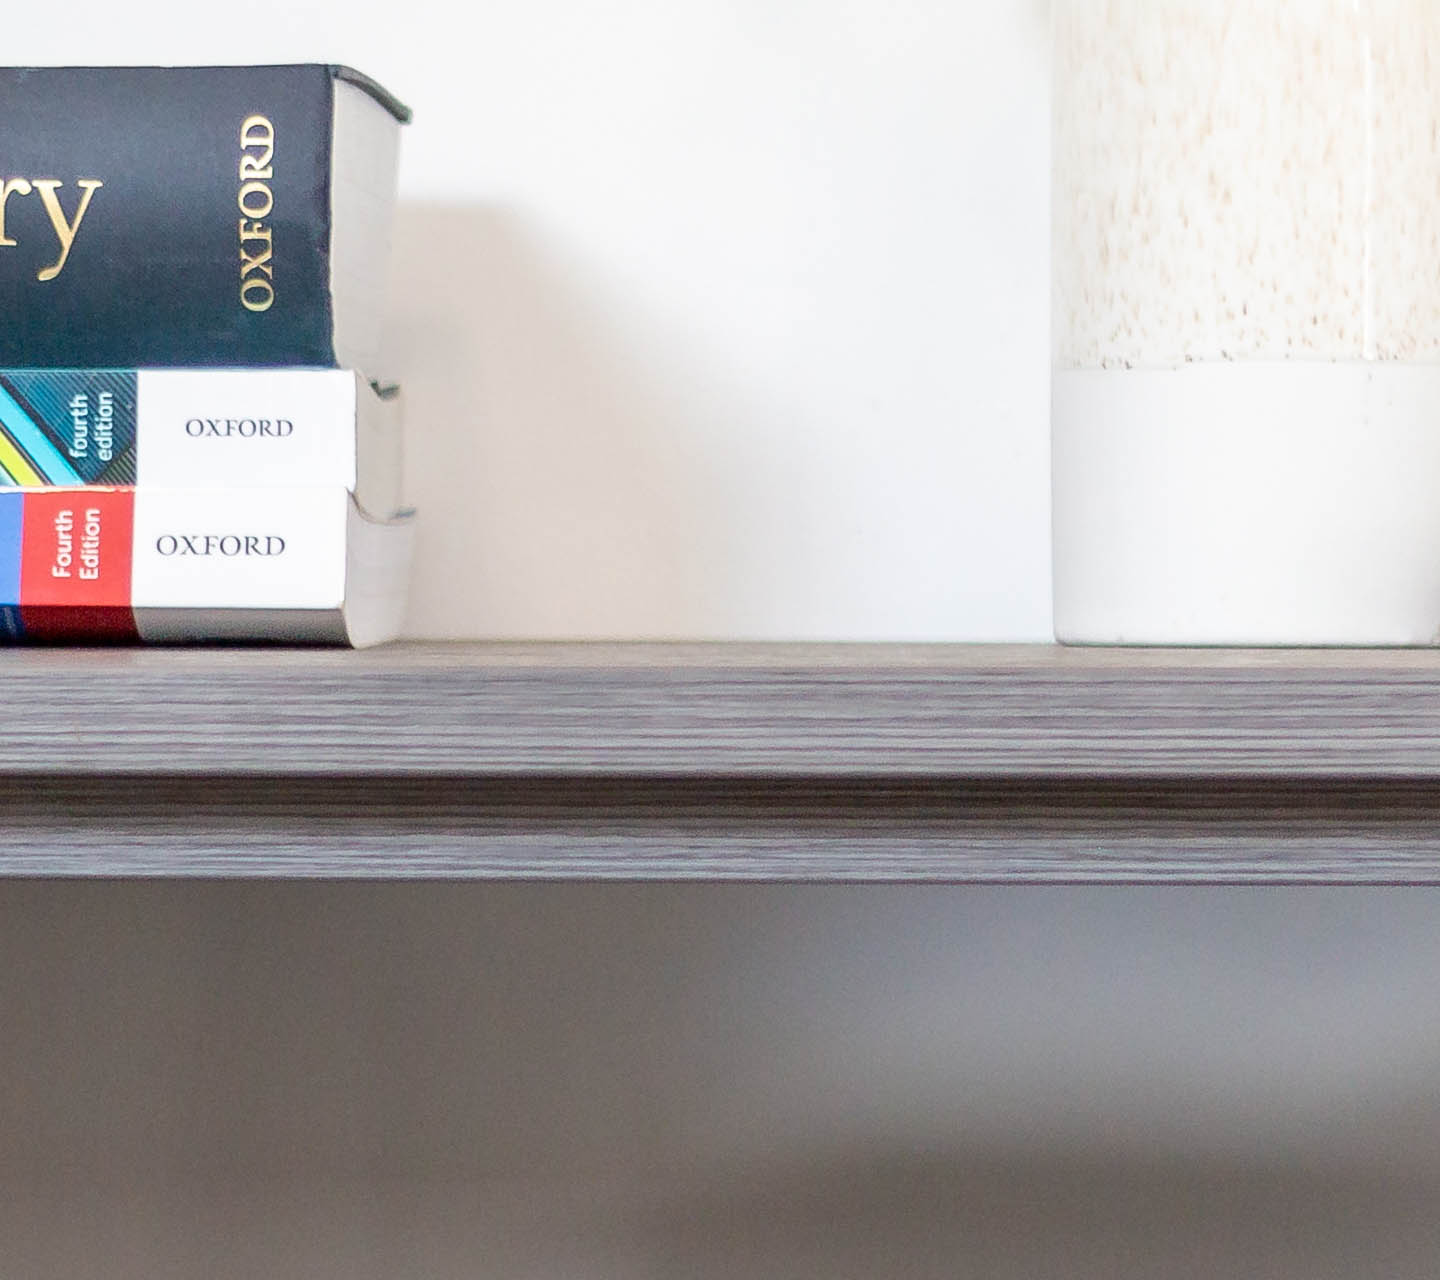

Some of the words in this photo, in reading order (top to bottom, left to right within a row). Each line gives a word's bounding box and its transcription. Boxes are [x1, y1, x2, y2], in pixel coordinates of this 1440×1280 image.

[238, 115, 274, 311] OXFORD
[69, 394, 87, 460] fourth
[94, 392, 113, 460] edition
[186, 419, 293, 436] OXFORD
[52, 511, 72, 577] Fourth
[79, 509, 100, 579] Edition
[157, 536, 285, 555] OXFORD
